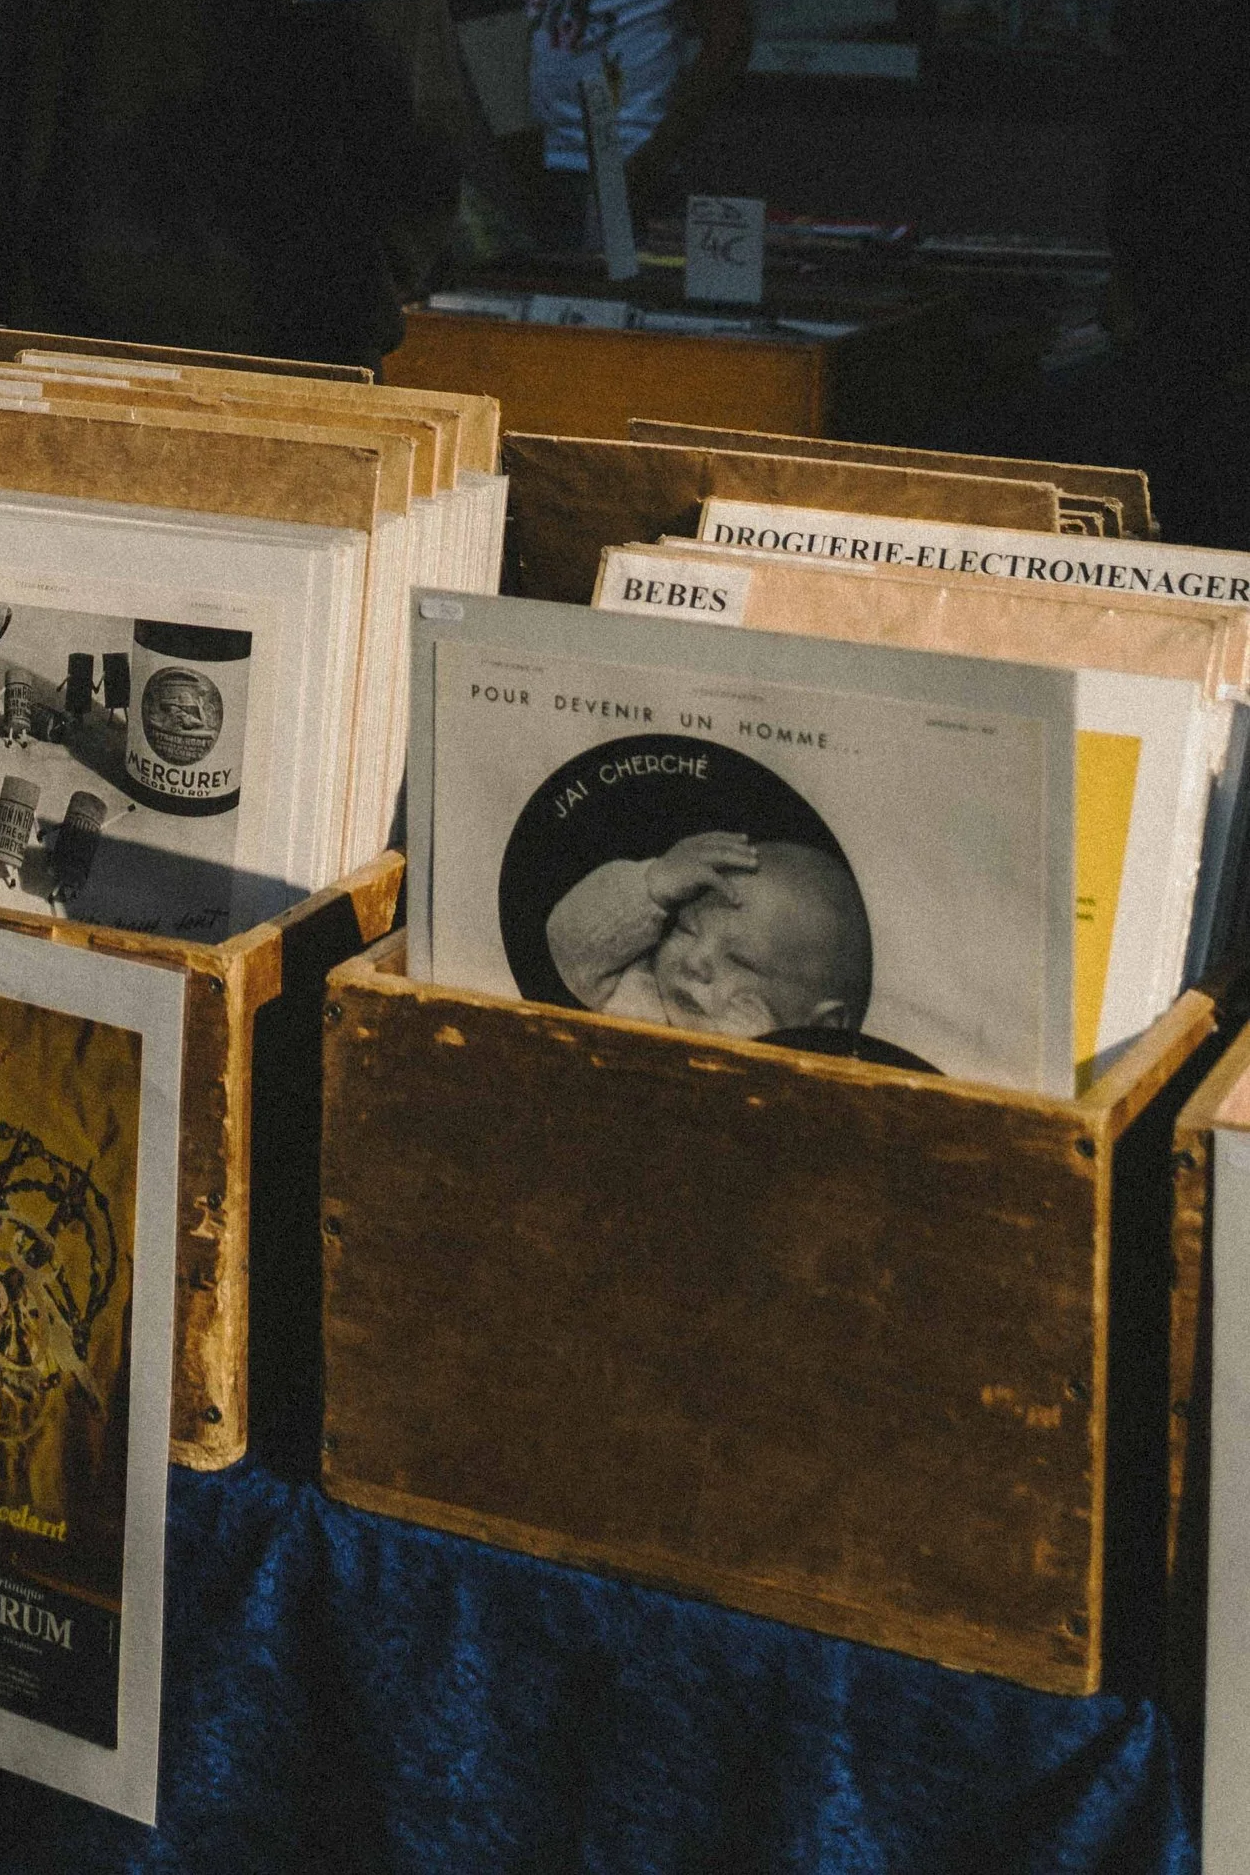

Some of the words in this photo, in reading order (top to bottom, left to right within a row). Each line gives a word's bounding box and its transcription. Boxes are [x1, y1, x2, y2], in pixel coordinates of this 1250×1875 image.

[621, 577, 728, 613] BEBES
[470, 683, 530, 705] POUR
[553, 694, 654, 723] DEVENIR
[679, 712, 712, 731] UN
[127, 749, 232, 790] MERCUREY
[554, 780, 589, 819] J'AI
[599, 753, 709, 785] CHERCHÉ
[169, 786, 185, 795] DU
[187, 788, 212, 798] ROY
